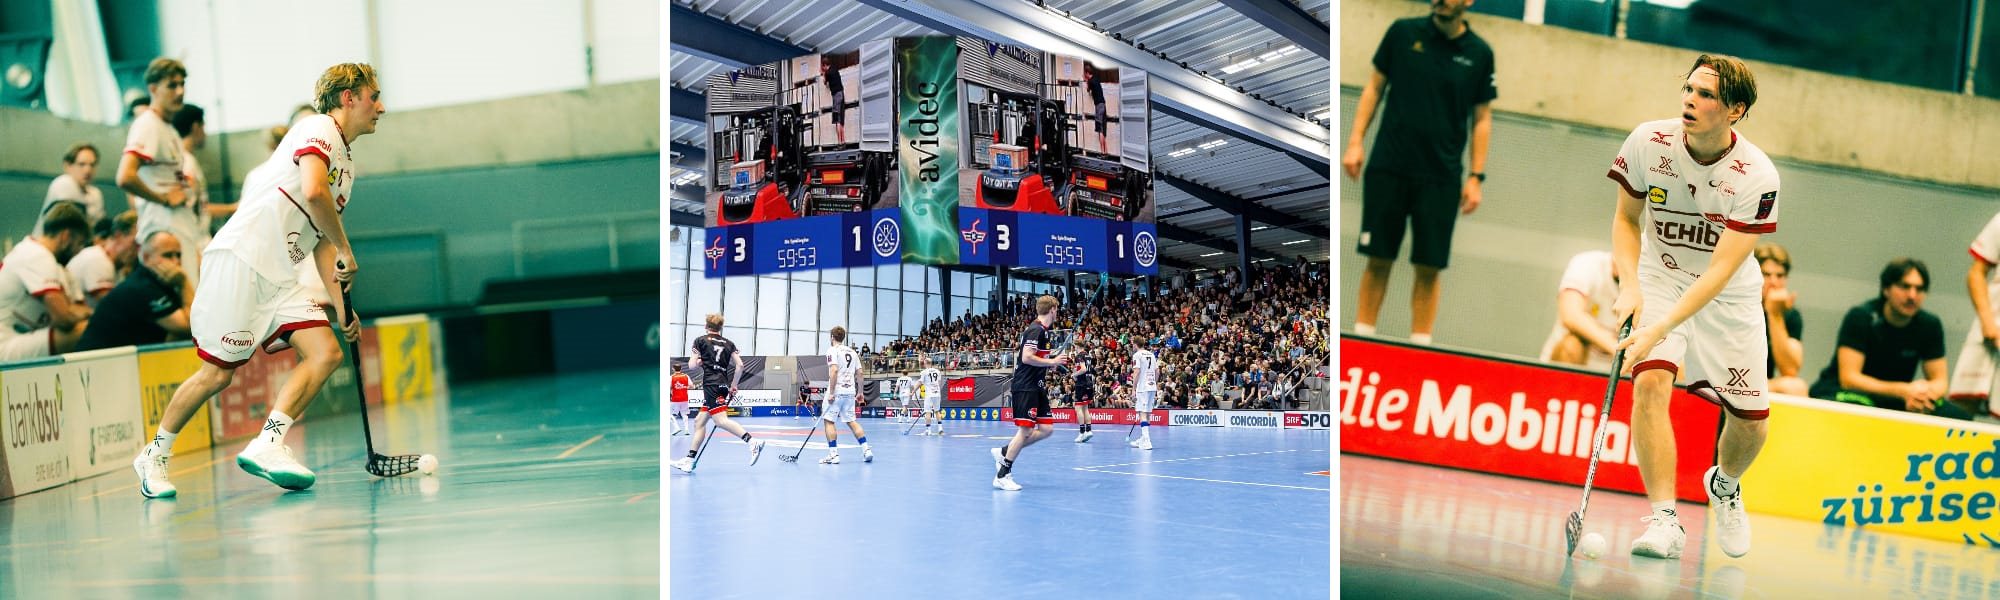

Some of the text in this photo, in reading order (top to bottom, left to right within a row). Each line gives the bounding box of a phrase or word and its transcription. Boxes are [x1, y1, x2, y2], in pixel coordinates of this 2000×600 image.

[908, 81, 940, 183] avidec
[852, 225, 861, 252] 1
[996, 224, 1010, 250] 3
[1115, 233, 1124, 258] 1
[733, 237, 746, 262] 3
[777, 247, 816, 268] 59:53
[1045, 244, 1083, 265] 59:53
[713, 345, 725, 362] 7
[845, 353, 852, 369] 9
[1145, 356, 1152, 370] 7
[928, 372, 939, 383] 19
[1340, 367, 1409, 431] die
[1174, 413, 1218, 425] CONCORDIA
[1230, 415, 1278, 427] CONCORDIA
[1286, 416, 1301, 424] SRF
[1822, 481, 2000, 527] zürise
